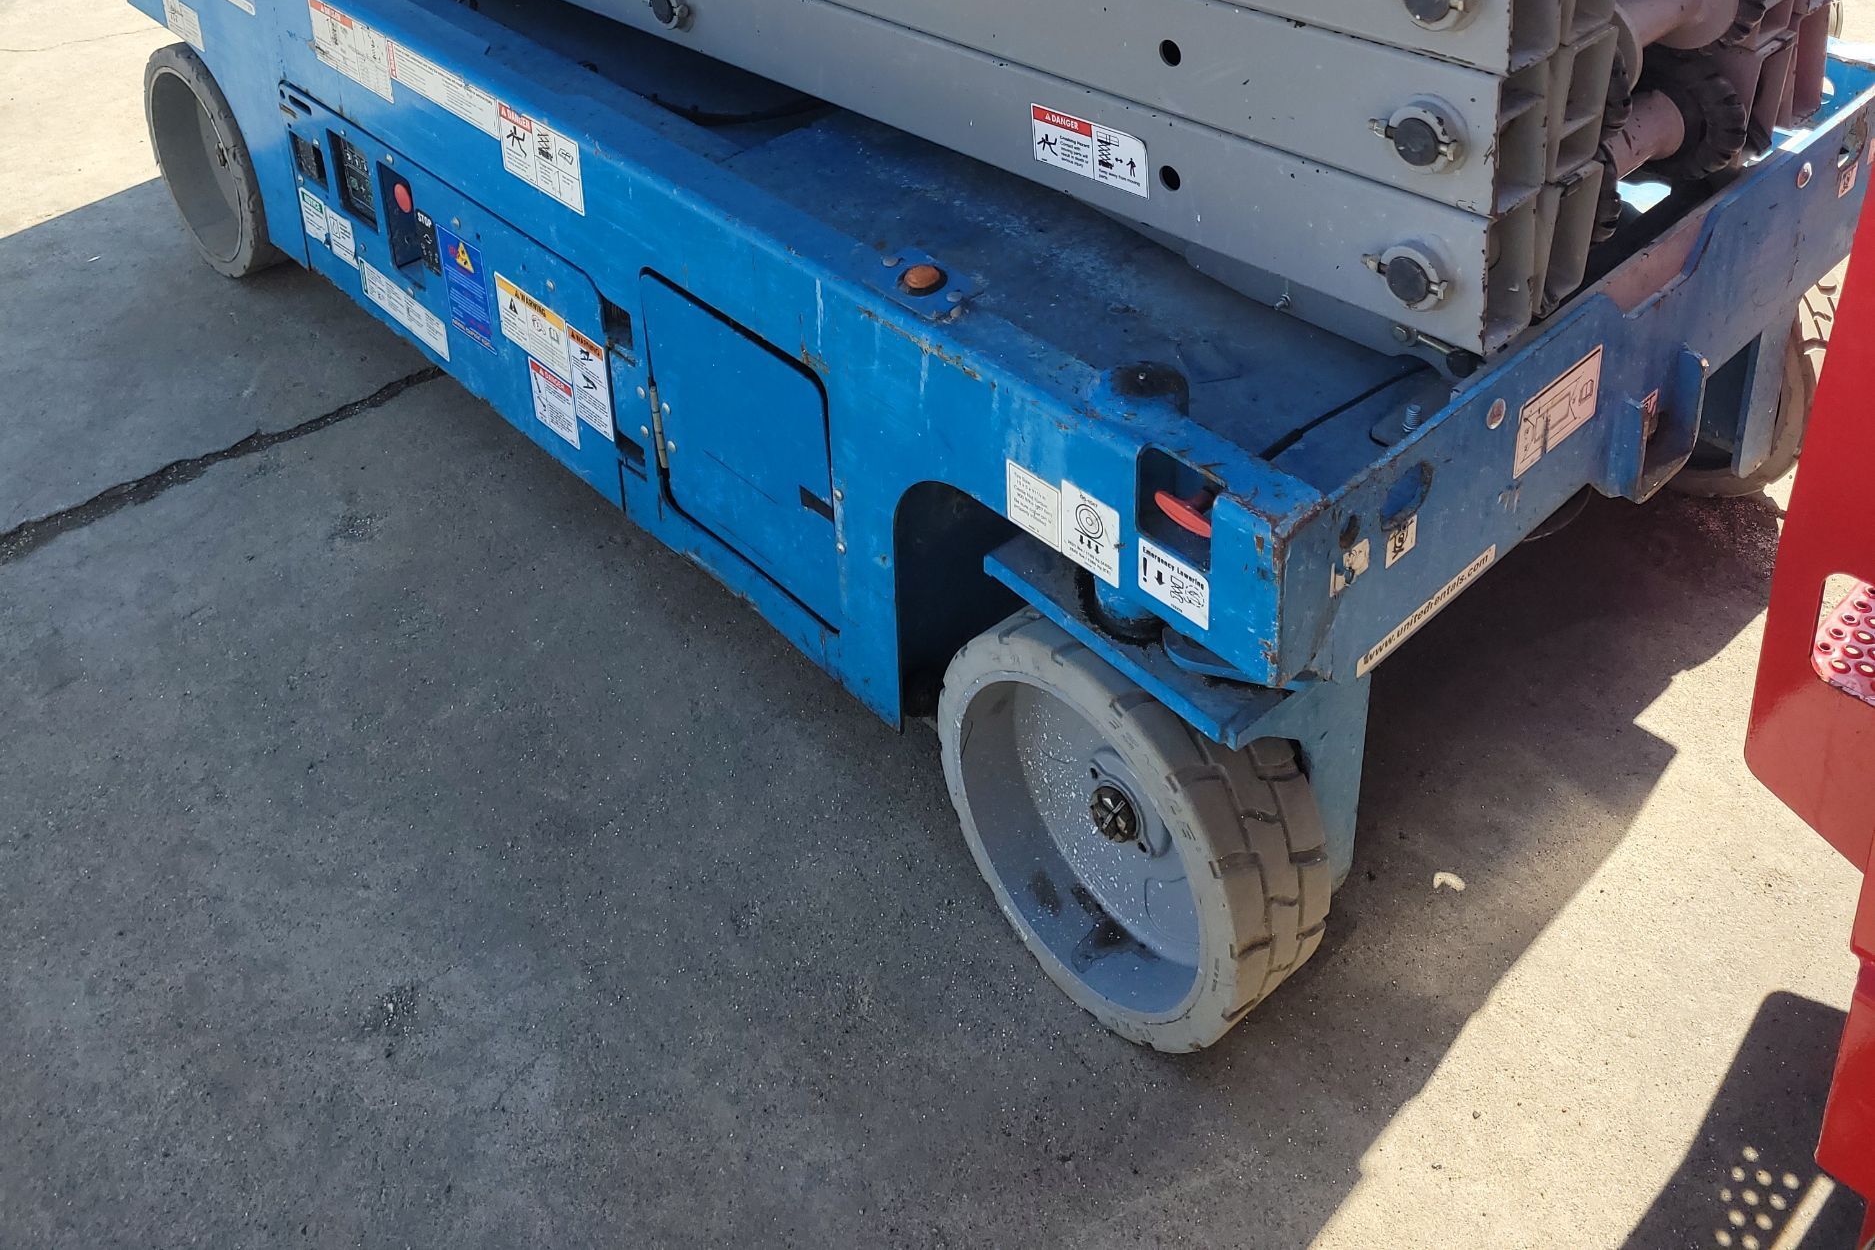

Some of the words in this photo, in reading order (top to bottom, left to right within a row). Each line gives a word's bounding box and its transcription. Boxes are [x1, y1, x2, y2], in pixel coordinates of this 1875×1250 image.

[1051, 114, 1078, 130] DANGER
[417, 212, 432, 228] STOP
[519, 291, 546, 318] WARNING
[1142, 545, 1174, 572] Emergency
[1177, 566, 1204, 591] Lowering
[1363, 554, 1490, 665] www.unitedrentals.com
